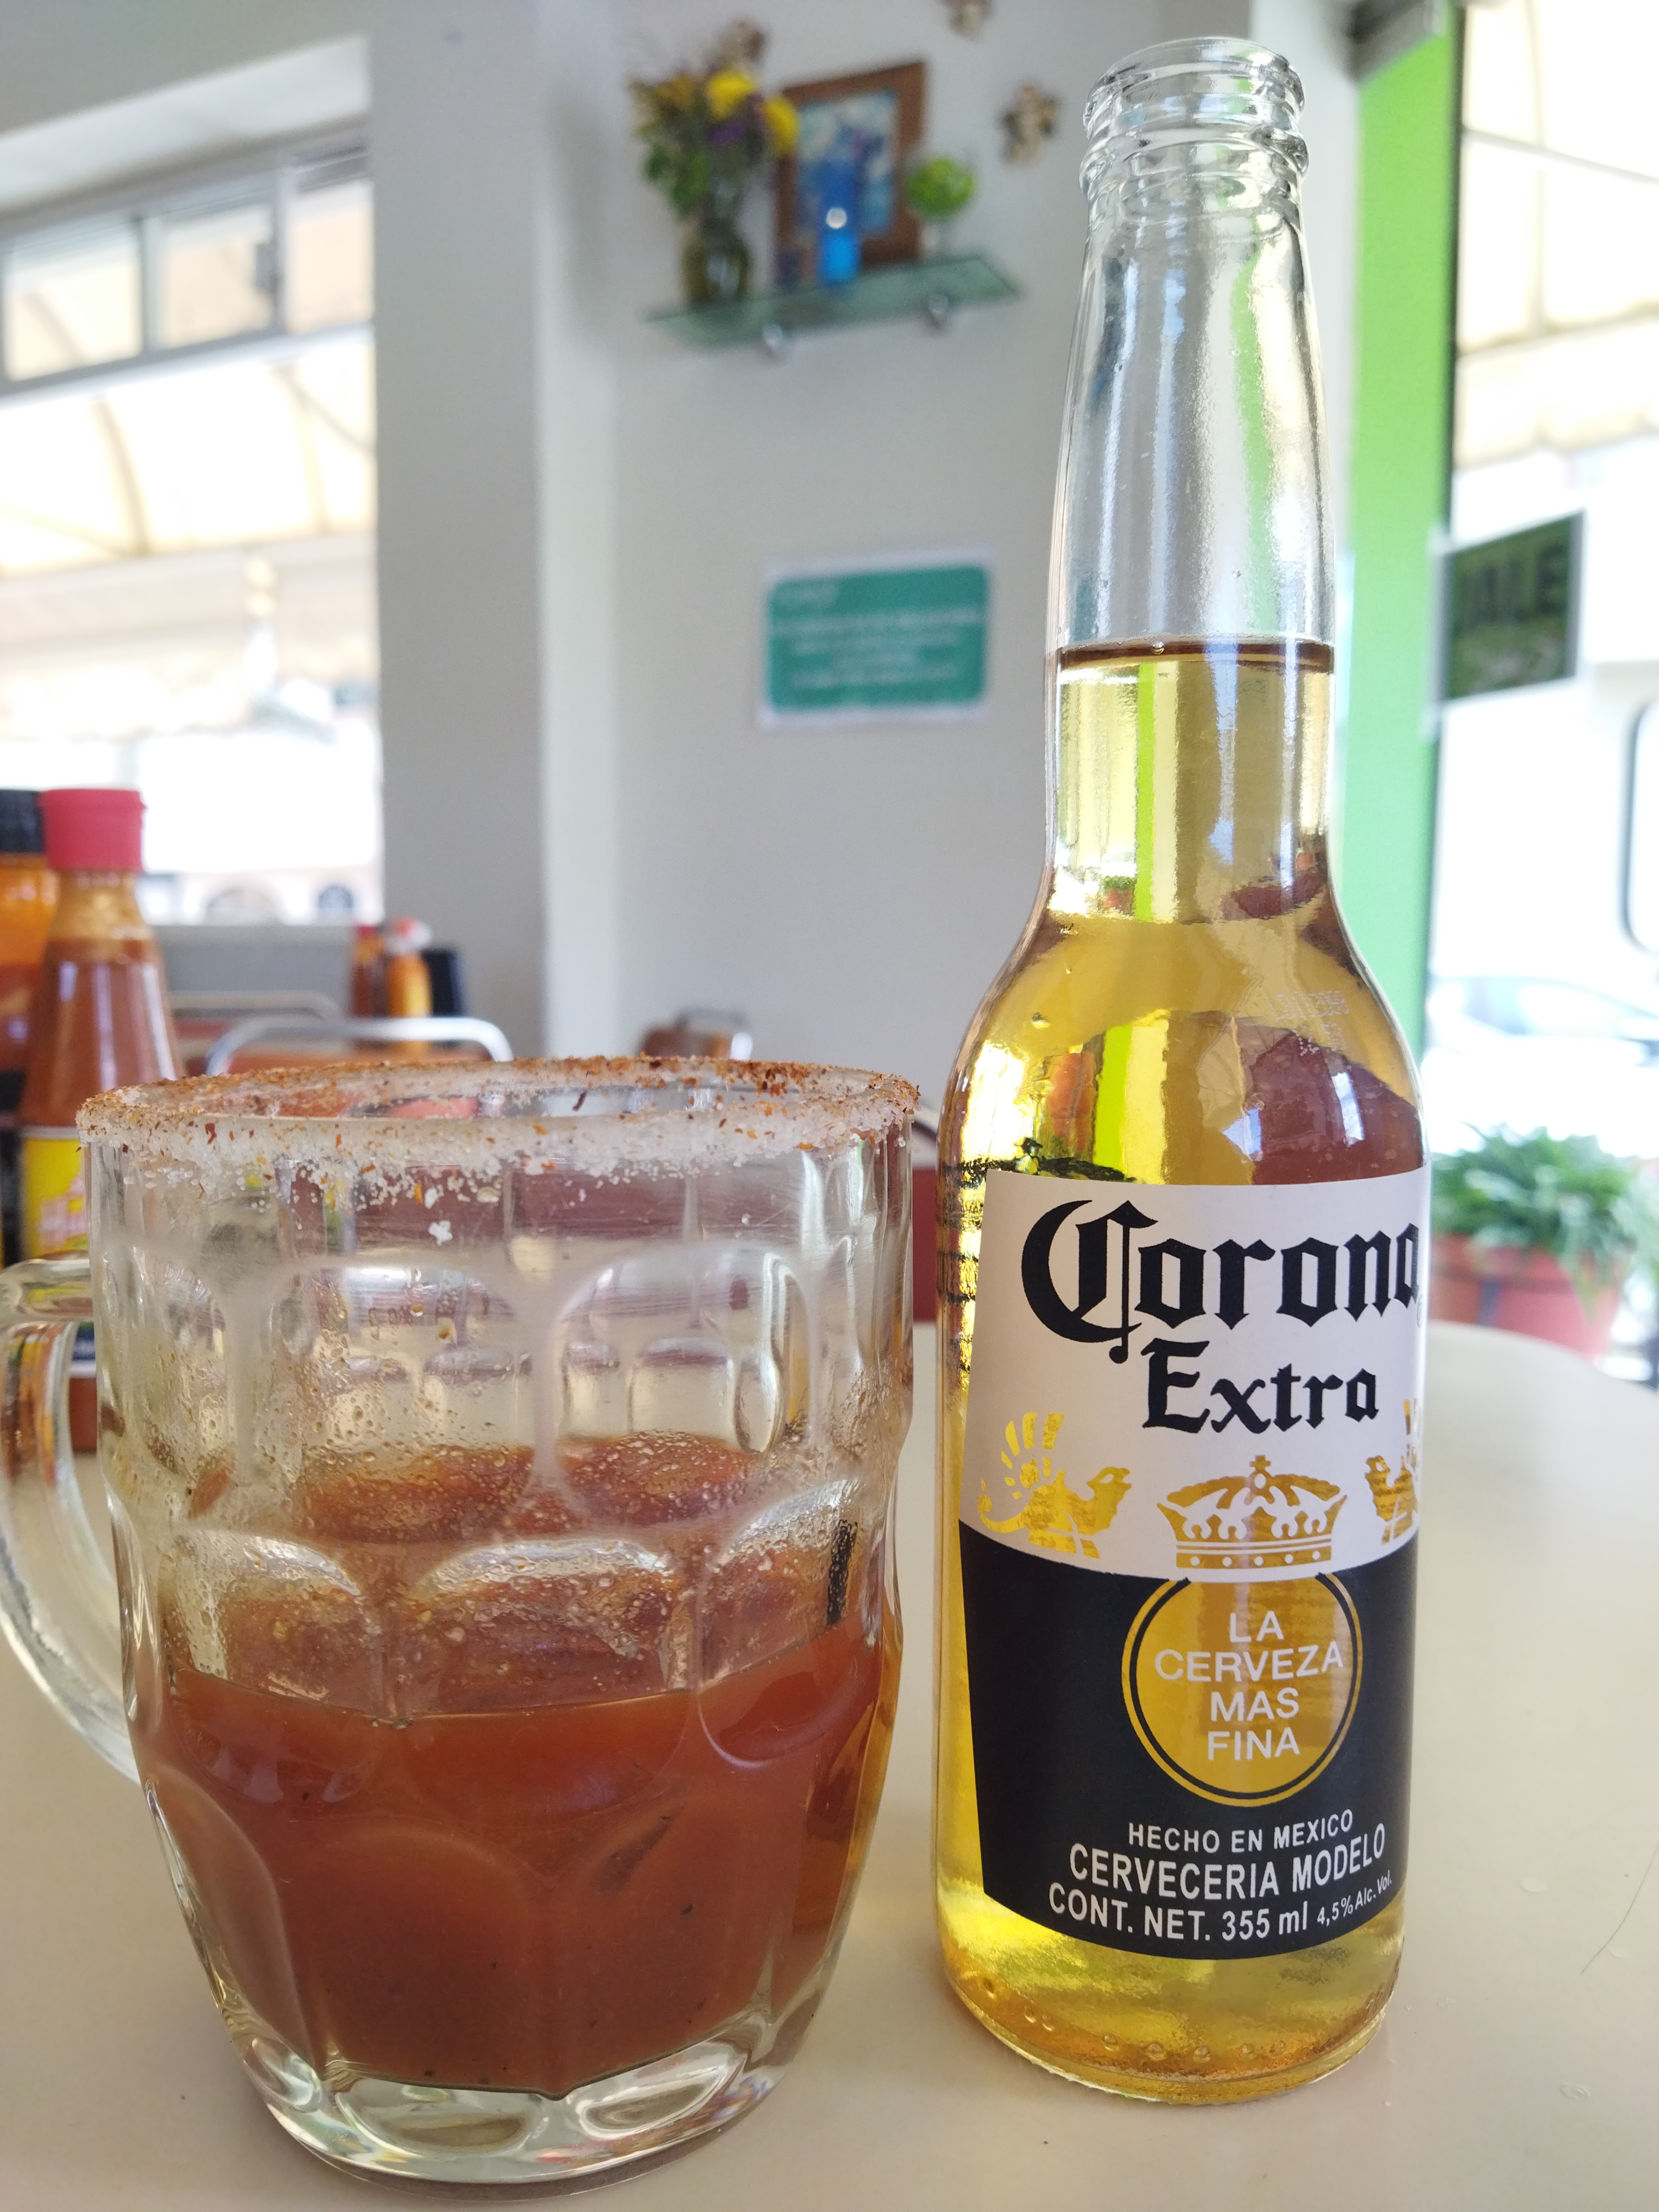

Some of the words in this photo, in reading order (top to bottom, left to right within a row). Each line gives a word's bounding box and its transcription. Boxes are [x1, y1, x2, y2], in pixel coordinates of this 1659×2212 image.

[1021, 1199, 1420, 1364] Corona
[1140, 1337, 1380, 1434] Extra
[1229, 1610, 1284, 1643] LA
[1155, 1641, 1344, 1682] CERVEZA
[1211, 1687, 1300, 1722] MAS
[1208, 1727, 1300, 1761] FINA
[1129, 1822, 1220, 1854] HECHO
[1231, 1828, 1262, 1853] EN
[1274, 1809, 1353, 1850] MEXICO
[1070, 1843, 1280, 1900] CERVECERIA
[1292, 1823, 1386, 1893] MODELO
[1048, 1882, 1134, 1933] CONT.
[1144, 1906, 1211, 1941] NET.
[1221, 1908, 1270, 1942] 355
[1279, 1901, 1308, 1936] ml
